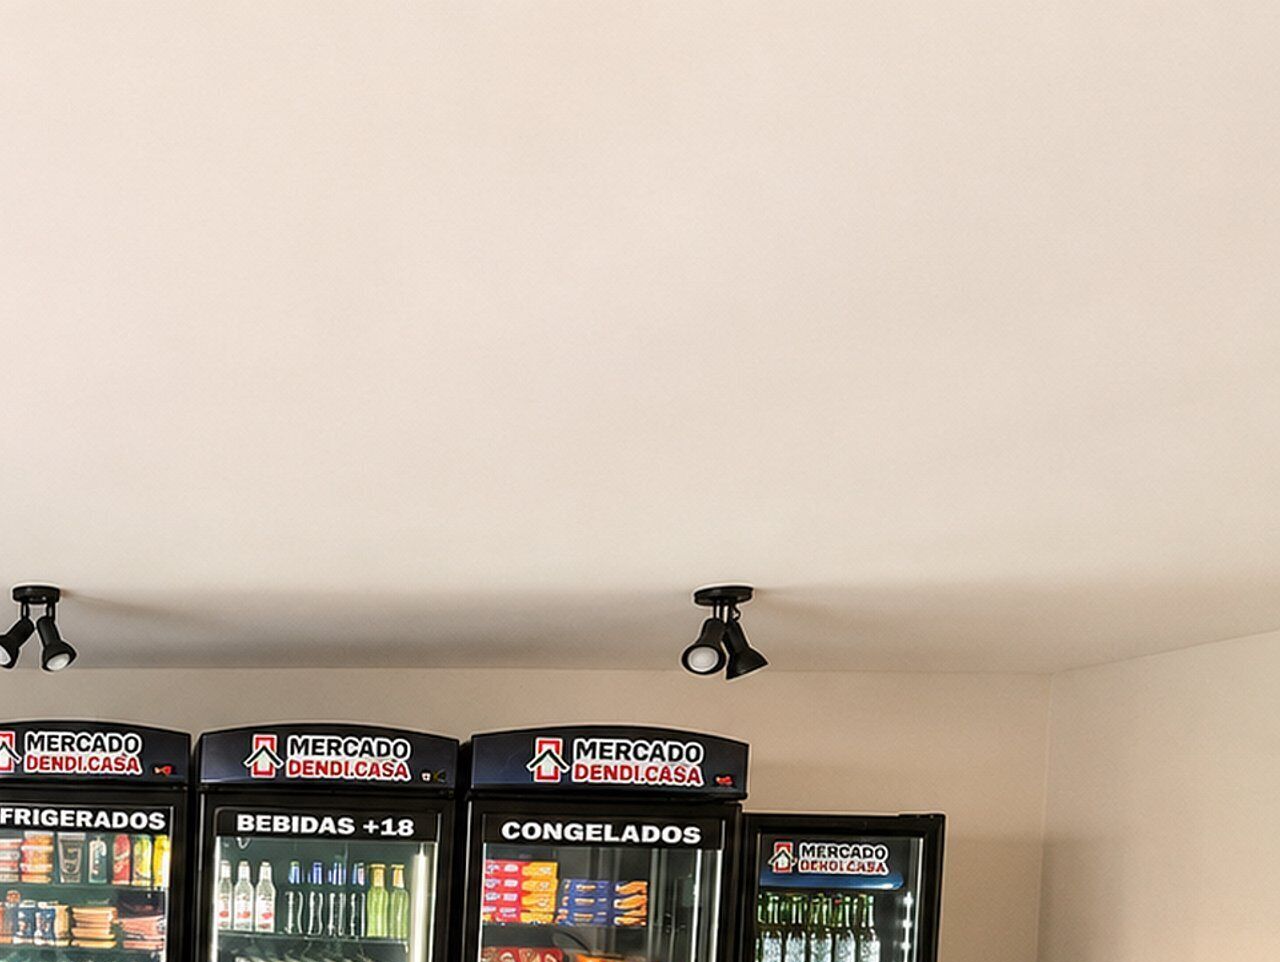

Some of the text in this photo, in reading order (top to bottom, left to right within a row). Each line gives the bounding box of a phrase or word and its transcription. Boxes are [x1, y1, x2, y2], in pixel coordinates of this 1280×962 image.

[25, 732, 140, 755] MERCADO
[288, 736, 410, 760] MERCADO
[574, 740, 702, 763] MERCADO
[25, 754, 141, 773] DENDI.CASA
[287, 759, 409, 779] DENDI.CASA
[573, 763, 702, 784] DENDI.CASA
[236, 814, 414, 836] BEBIDAS +18
[501, 821, 702, 844] CONGELADOS
[800, 844, 887, 861] MERCADO
